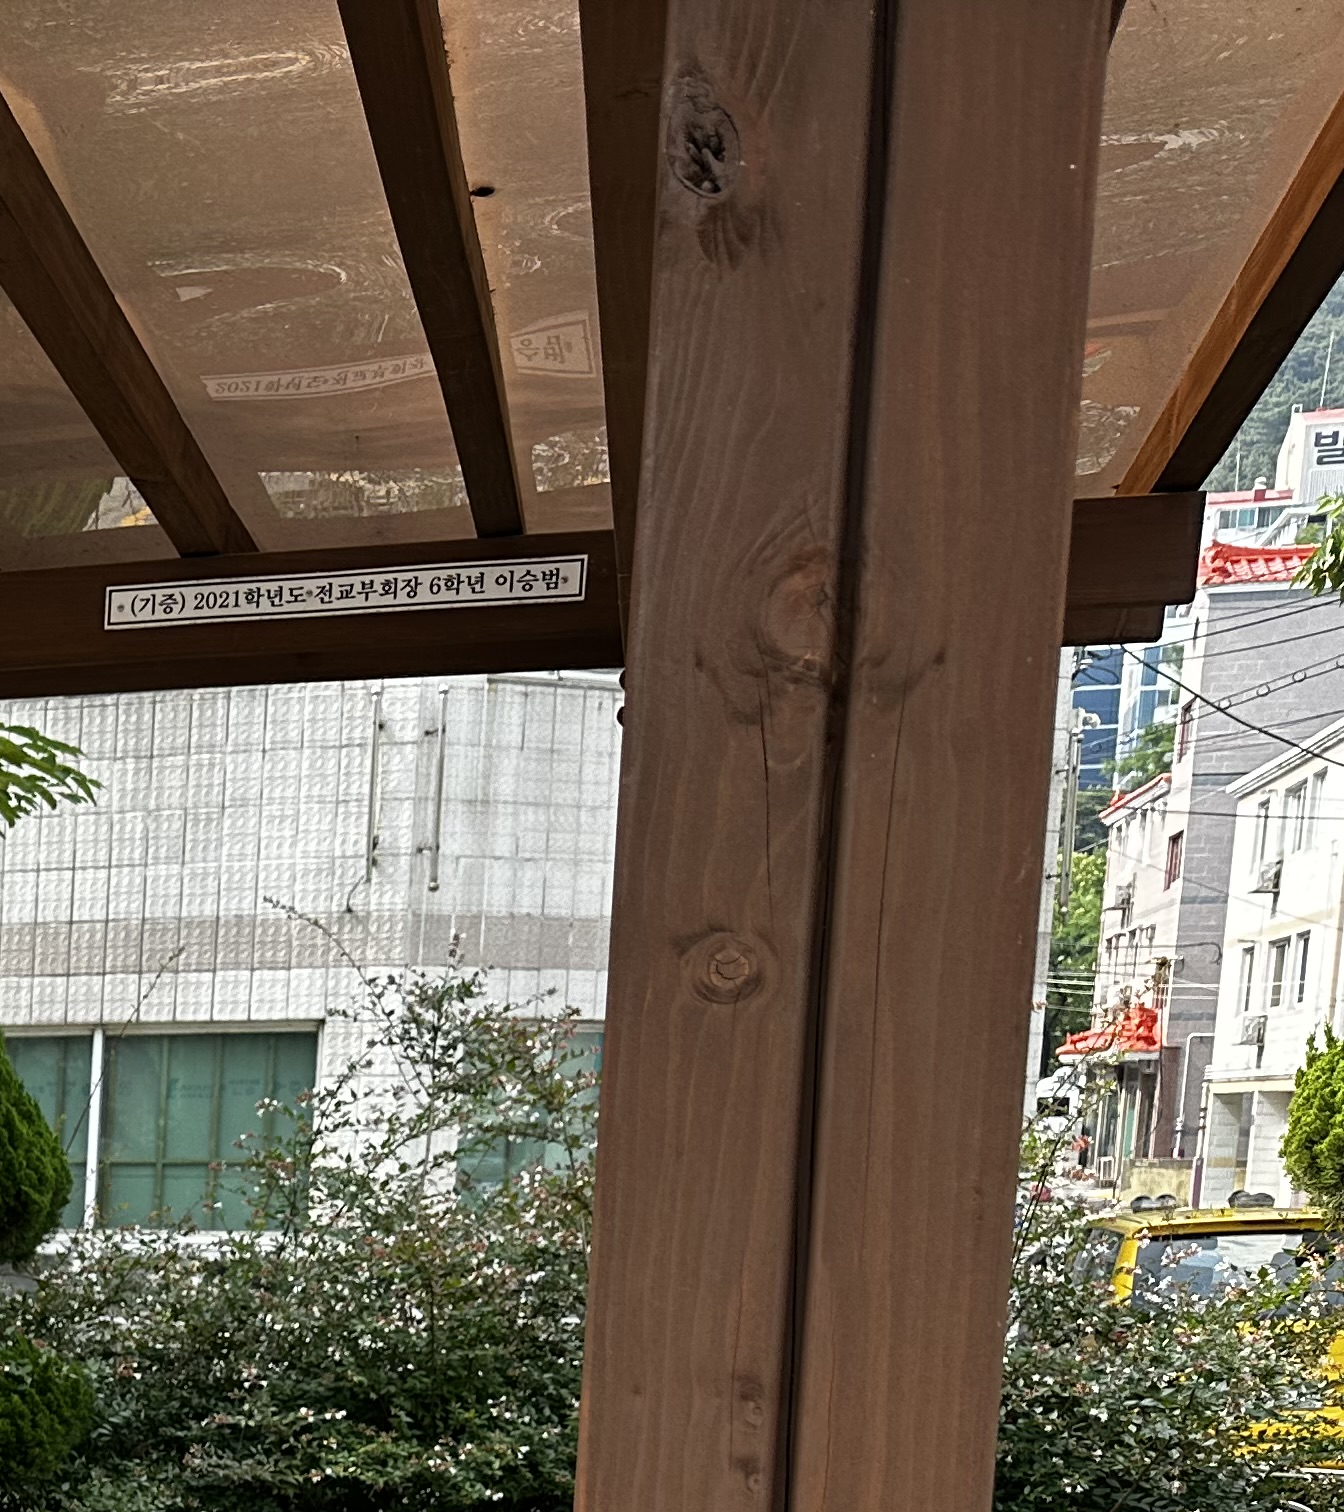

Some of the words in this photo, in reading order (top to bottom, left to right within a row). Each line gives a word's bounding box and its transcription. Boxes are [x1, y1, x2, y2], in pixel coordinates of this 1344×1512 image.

[130, 592, 186, 618] (기증)
[193, 585, 308, 611] 2021학년도
[313, 576, 423, 605] 전교부회장
[428, 571, 486, 597] 6학년
[494, 567, 562, 594] 이승범
